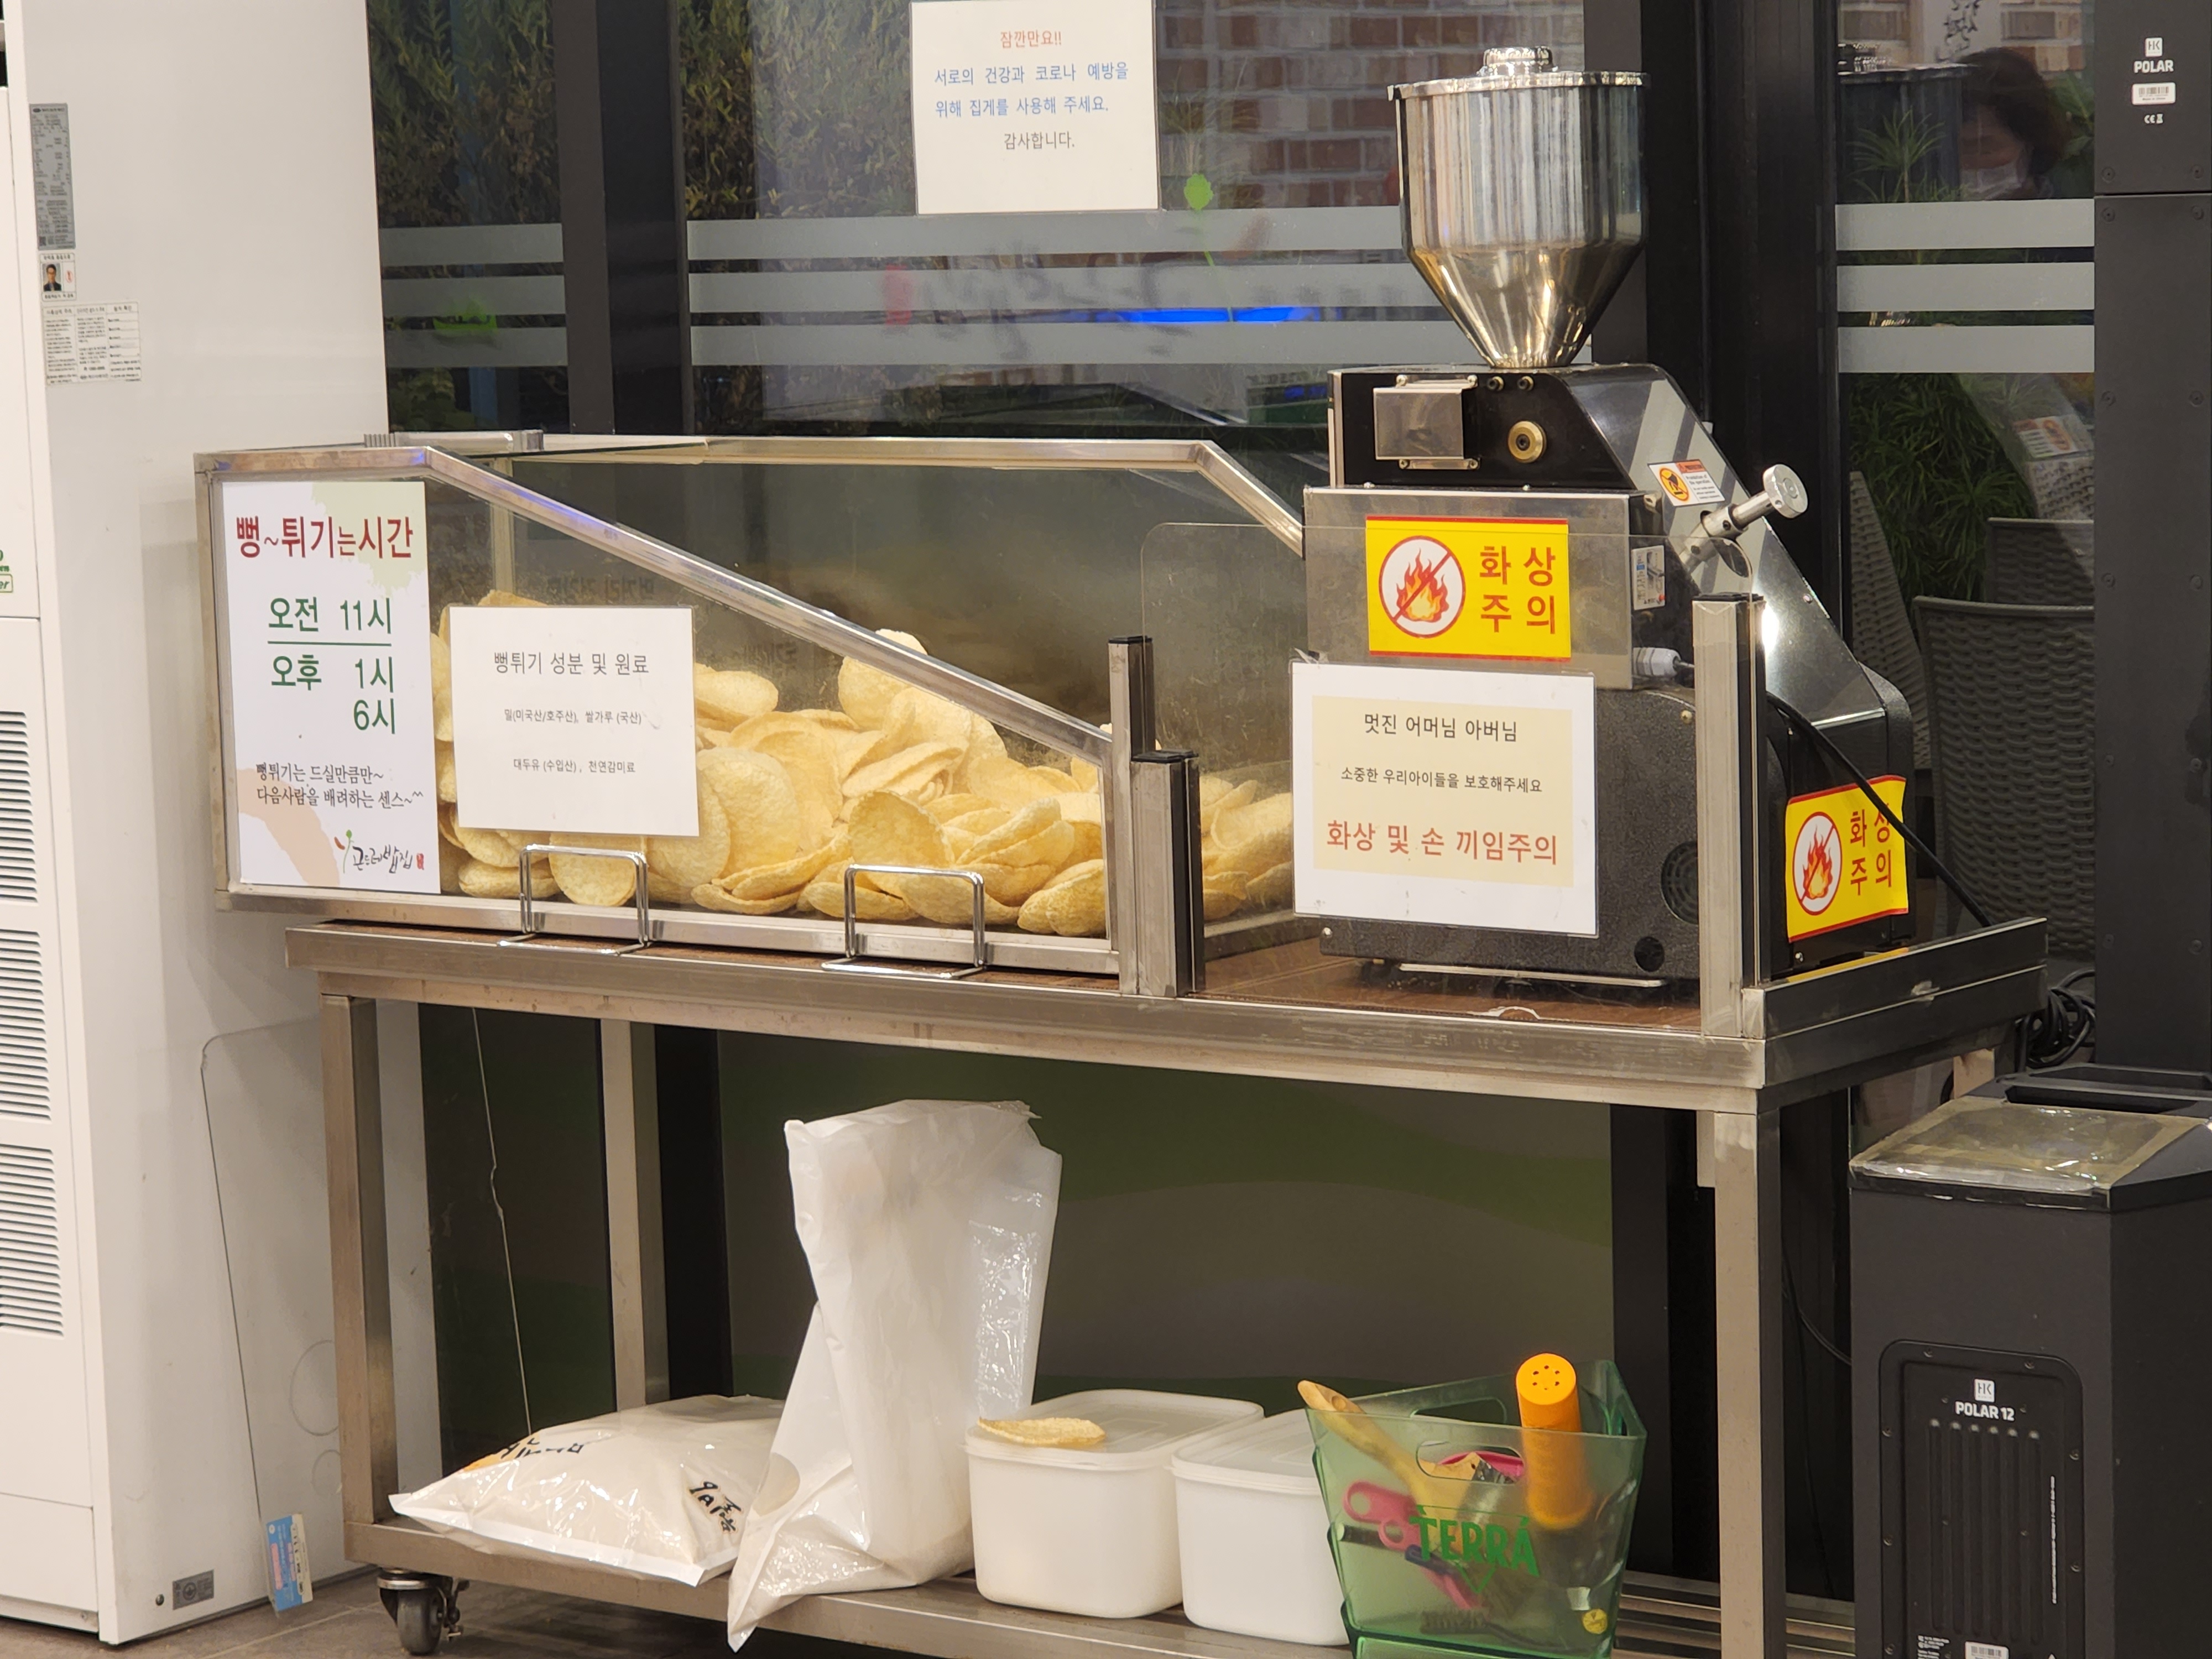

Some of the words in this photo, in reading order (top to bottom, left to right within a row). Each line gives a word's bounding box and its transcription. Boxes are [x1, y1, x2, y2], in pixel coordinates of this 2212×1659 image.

[1000, 30, 1062, 49] 잠깐만요!!
[934, 67, 973, 87] 서로의
[985, 65, 1025, 84] 건강과
[1035, 63, 1076, 82] 코로나
[1087, 61, 1129, 81] 예방을
[2133, 60, 2174, 73] POLAR
[936, 100, 962, 118] 위해
[969, 98, 1009, 117] 집게를
[1016, 96, 1056, 116] 사용해
[1063, 95, 1109, 114] 주세요.
[1004, 131, 1074, 150] 감사합니다.
[268, 596, 319, 632] 오전
[340, 597, 392, 634] 11시
[271, 654, 322, 691] 오후
[354, 656, 394, 693] 1시
[494, 651, 541, 675] 뻥튀기
[550, 652, 583, 675] 성분
[592, 653, 607, 675] 및
[614, 653, 649, 676] 원료
[353, 698, 395, 734] 6시
[585, 710, 613, 724] 쌀가루
[616, 711, 641, 726] (국산)
[1364, 713, 1396, 735] 멋진
[1406, 716, 1455, 739] 어머님
[1465, 719, 1516, 742] 아버님
[256, 763, 306, 781] 뻥튀기는
[310, 764, 383, 784] 드실만큼만~
[513, 758, 540, 771] 대두유
[588, 760, 636, 774] 천연감미료
[1341, 766, 1379, 783] 소중한
[1383, 769, 1459, 789] 우리아이들을
[1464, 775, 1542, 794] 보호해주세요
[257, 786, 319, 806] 다음사람을
[324, 788, 374, 808] 배려하는
[1327, 820, 1376, 852] 화상
[1387, 825, 1410, 854] 및
[1421, 827, 1445, 857] 손
[1456, 830, 1556, 865] 끼임주의
[1850, 849, 1892, 896] 주의
[1955, 1401, 1999, 1419] POLAR
[2000, 1407, 2015, 1421] 12
[1410, 1505, 1540, 1577] TERRA
